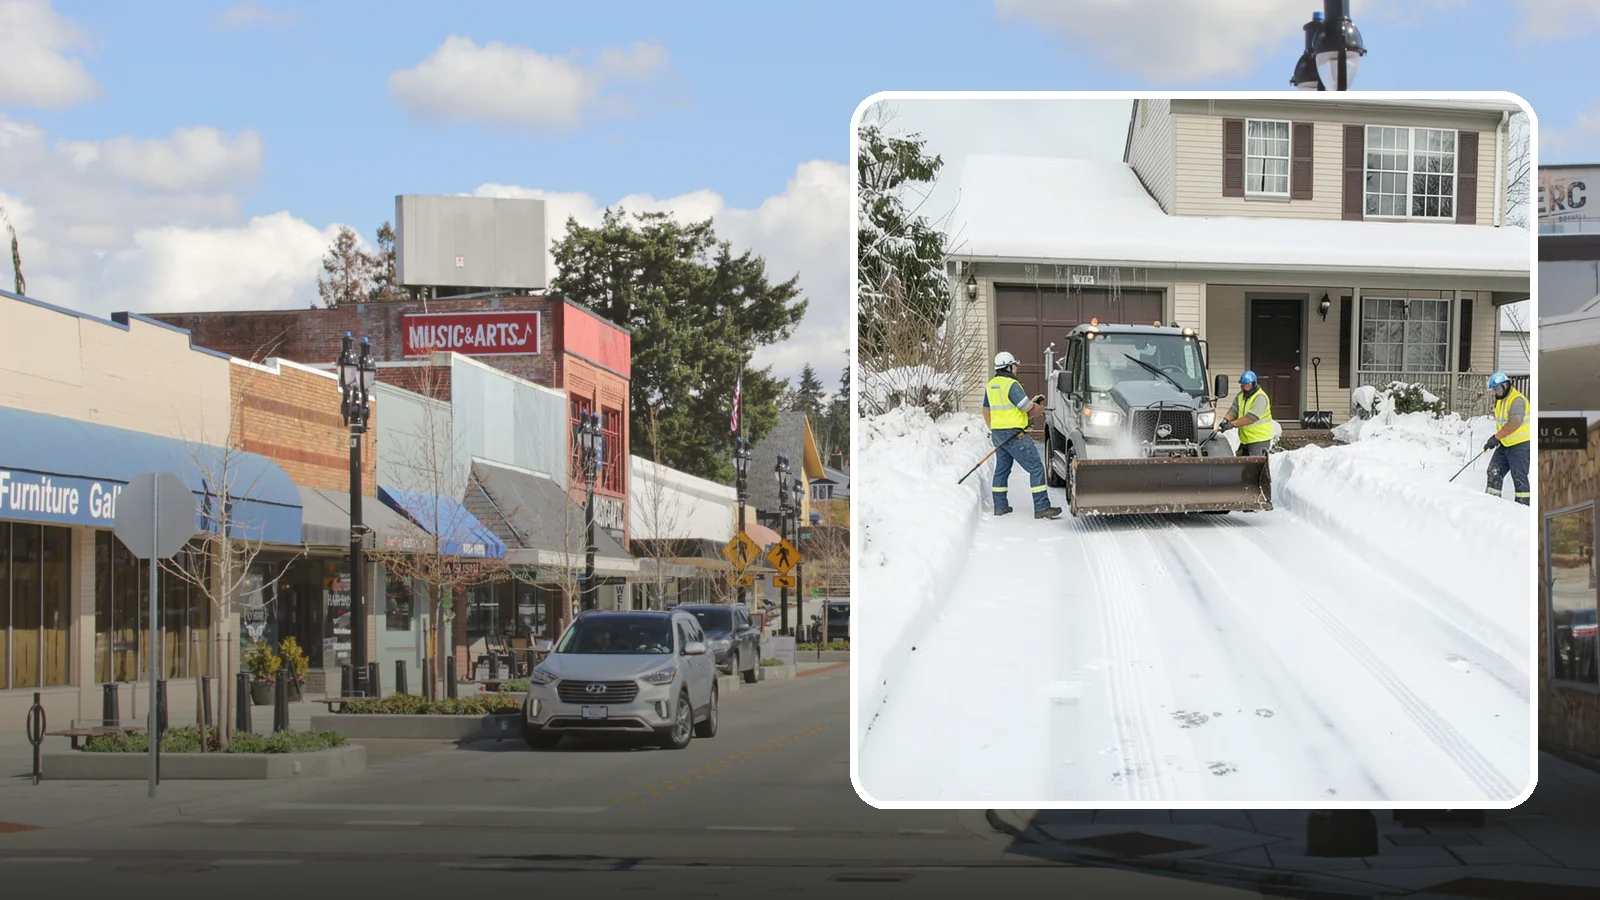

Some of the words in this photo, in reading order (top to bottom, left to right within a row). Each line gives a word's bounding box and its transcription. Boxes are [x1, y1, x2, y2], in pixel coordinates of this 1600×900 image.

[409, 323, 519, 349] MUSIC&ARTS
[1540, 427, 1577, 436] UGA
[0, 471, 79, 515] Furniture
[453, 563, 479, 574] SUSHI
